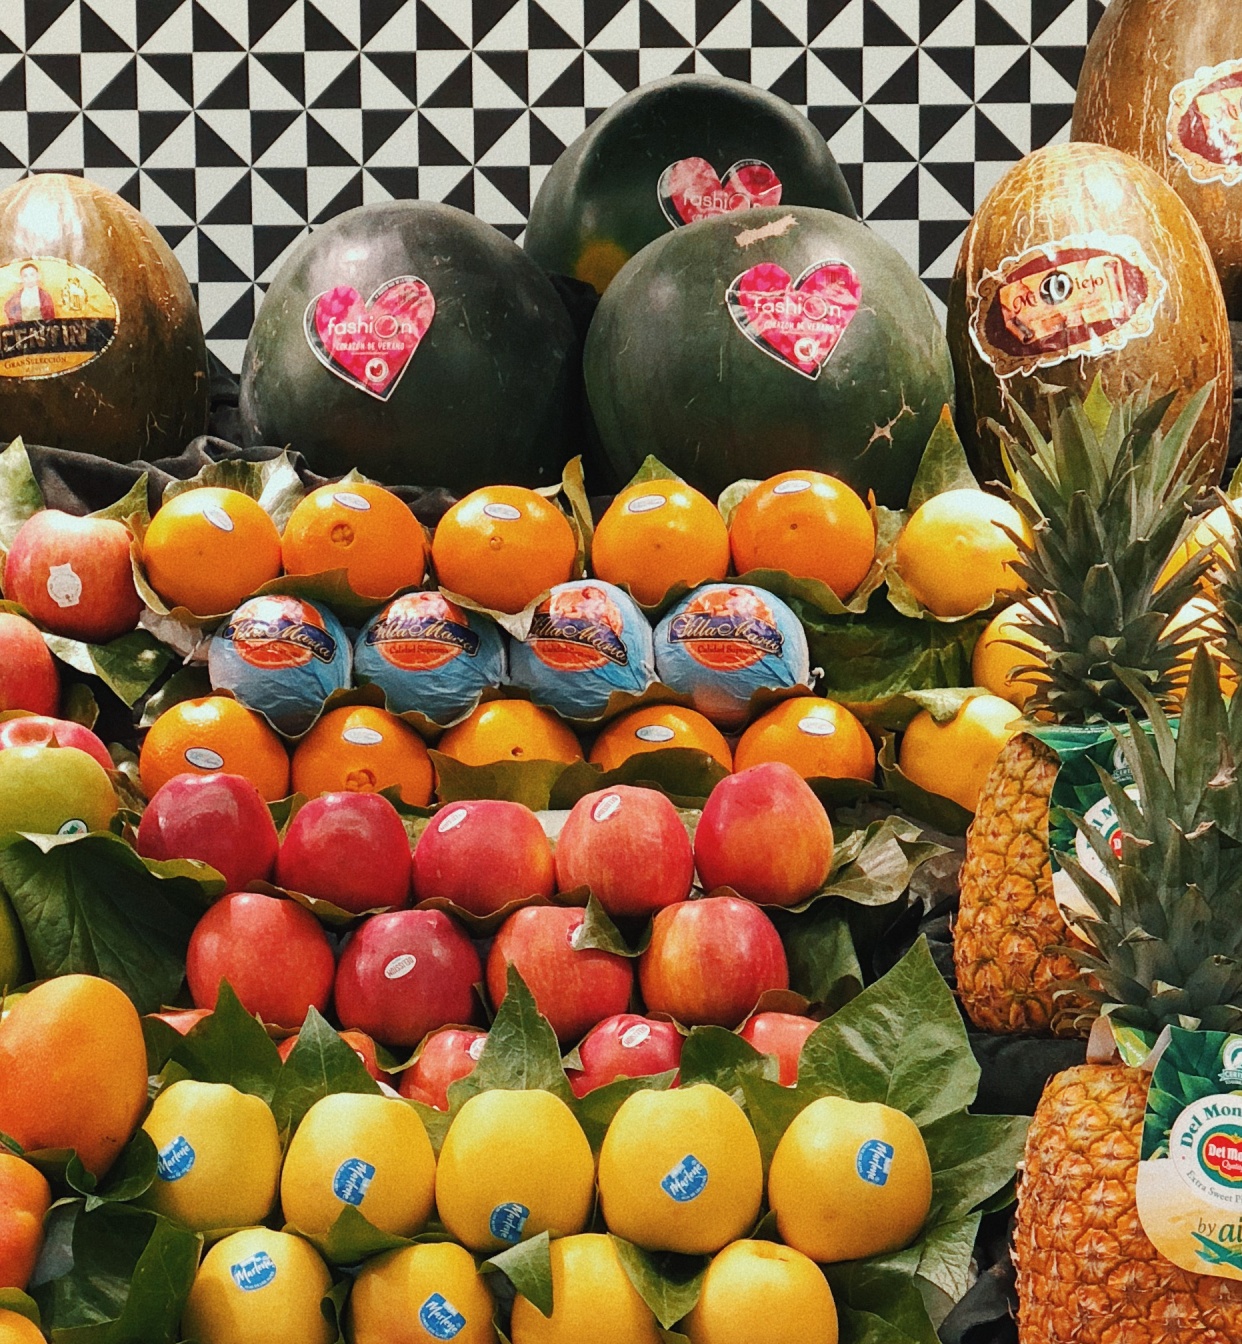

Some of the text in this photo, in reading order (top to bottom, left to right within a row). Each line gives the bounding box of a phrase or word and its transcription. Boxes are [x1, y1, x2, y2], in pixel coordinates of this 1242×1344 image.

[1012, 289, 1038, 313] Mi
[367, 342, 376, 350] DE
[378, 342, 405, 351] VERANO
[672, 614, 717, 638] Villa
[1180, 1114, 1203, 1148] Del
[157, 1145, 190, 1174] Marlene
[866, 1142, 887, 1180] Marlene
[1208, 1143, 1226, 1159] Del
[342, 1161, 367, 1200] Marlene
[670, 1163, 703, 1196] Marlene
[1186, 1170, 1207, 1191] Extra
[1208, 1186, 1233, 1202] Sweet
[499, 1203, 523, 1239] Marlene
[1197, 1217, 1217, 1237] by
[235, 1257, 276, 1285] Marlene
[426, 1301, 458, 1333] Marlene
